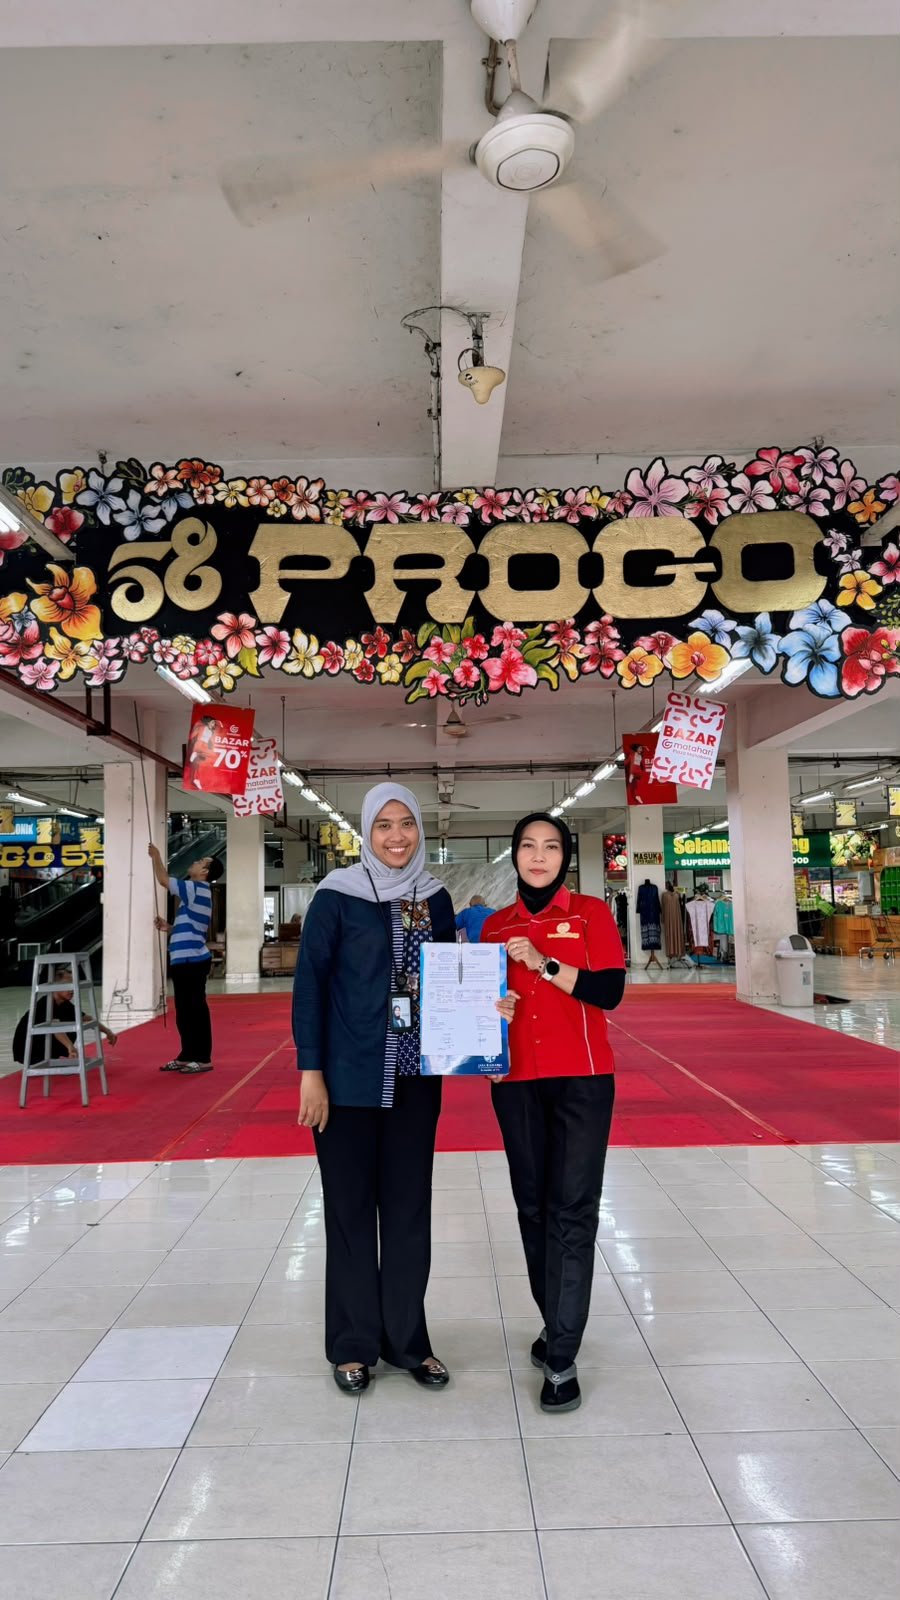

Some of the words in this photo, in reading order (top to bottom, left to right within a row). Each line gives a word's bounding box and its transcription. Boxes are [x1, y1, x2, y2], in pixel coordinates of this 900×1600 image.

[109, 516, 222, 622] 58
[248, 511, 828, 624] PROGO
[214, 735, 249, 747] BAZAR
[663, 725, 717, 747] BAZAR
[673, 742, 714, 756] matahari
[213, 748, 248, 769] 70%
[673, 837, 730, 855] Selam
[633, 852, 657, 860] MASUK
